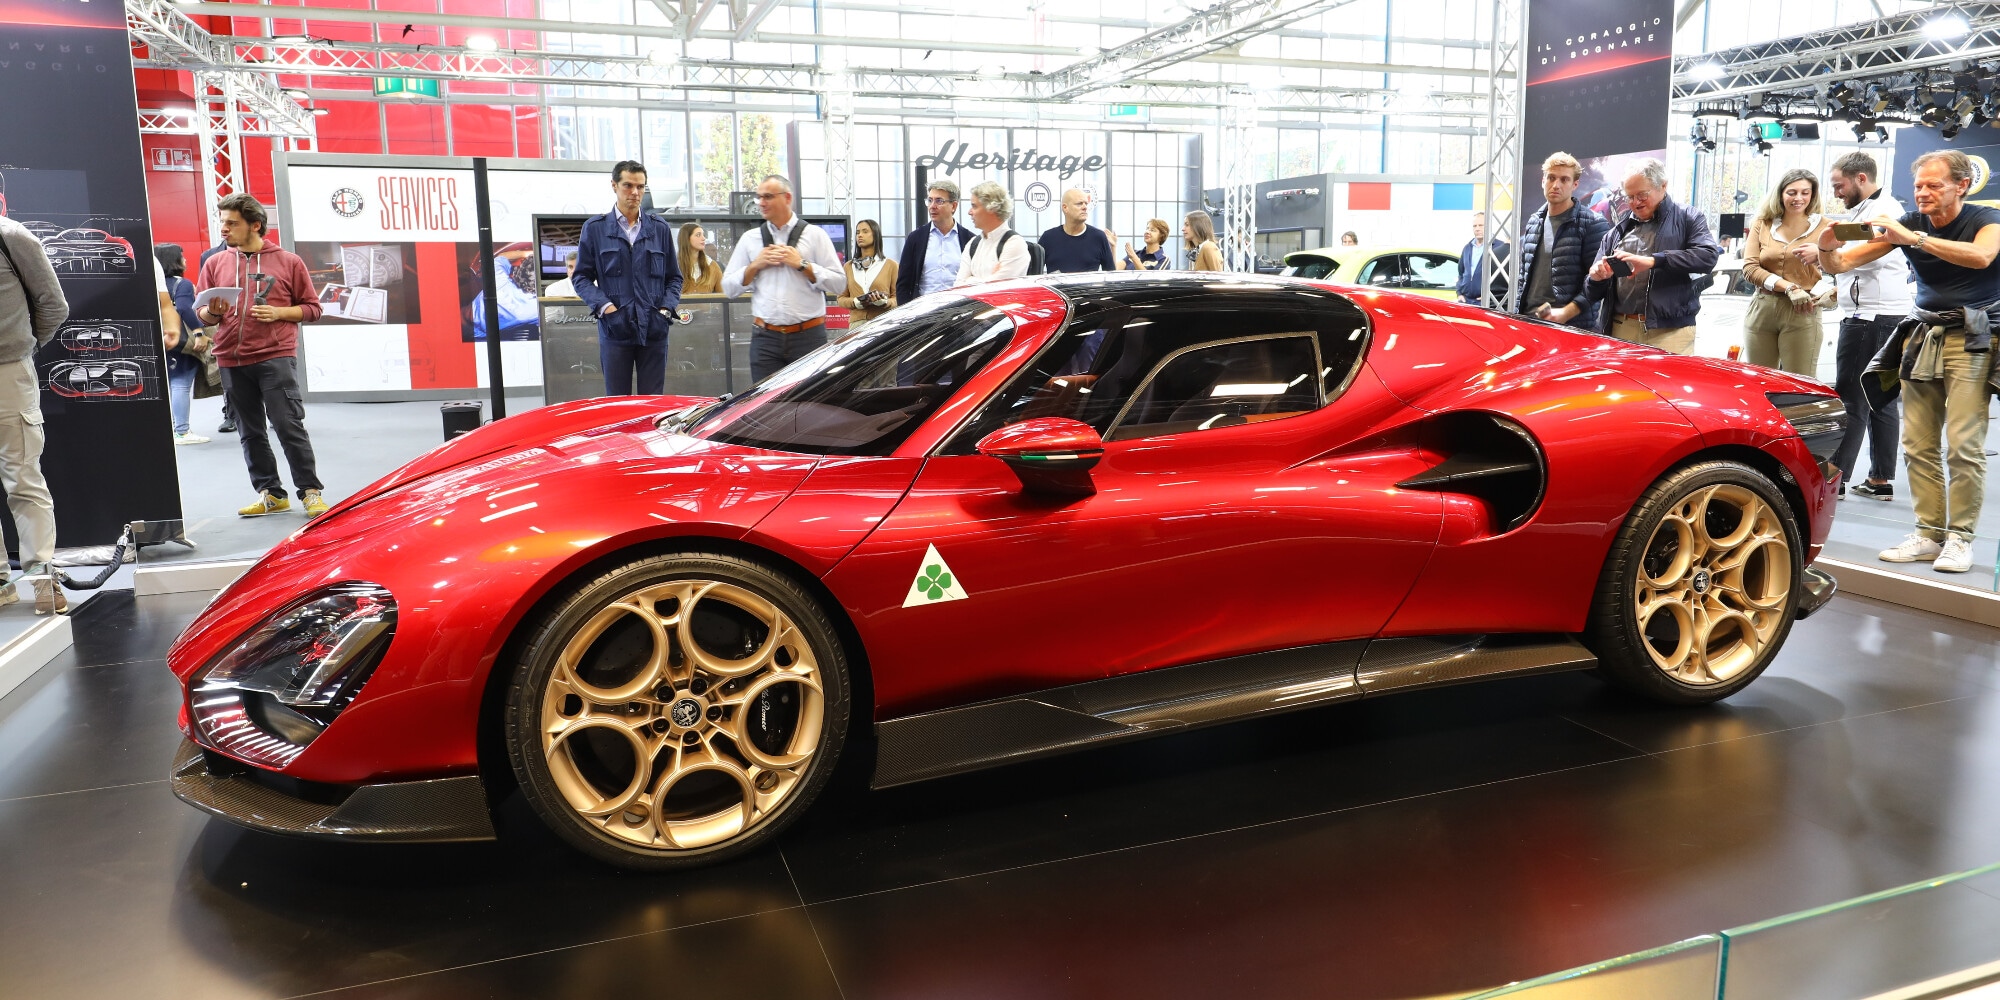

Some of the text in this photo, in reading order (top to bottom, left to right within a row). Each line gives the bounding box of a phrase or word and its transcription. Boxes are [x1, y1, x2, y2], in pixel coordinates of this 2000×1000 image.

[1537, 17, 1661, 52] IL CORAGGIO
[1541, 33, 1654, 65] DI SOGNARE
[915, 139, 1107, 180] Heritage
[377, 175, 459, 231] SERVICES
[555, 314, 598, 324] Heritag
